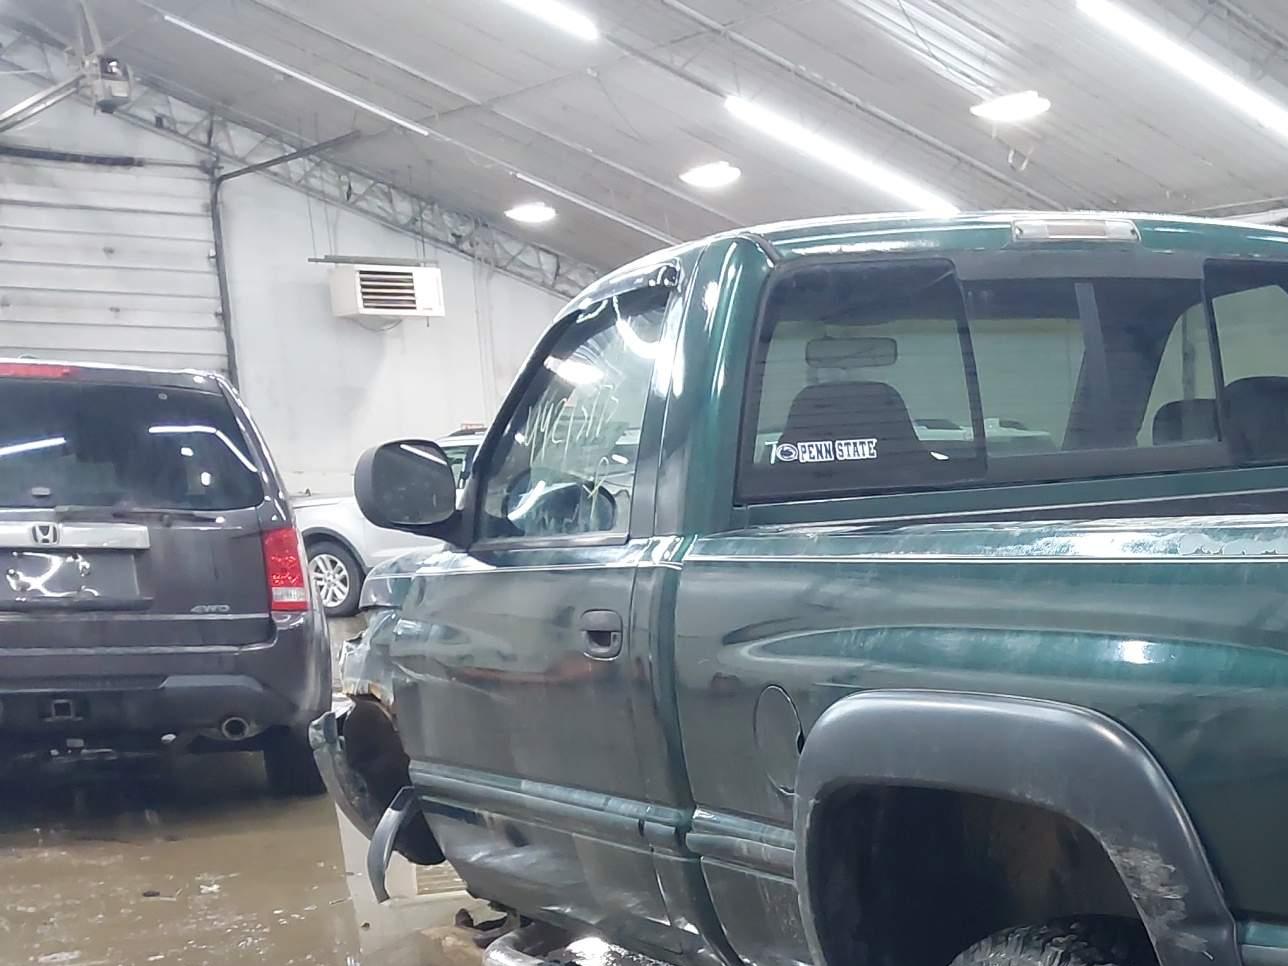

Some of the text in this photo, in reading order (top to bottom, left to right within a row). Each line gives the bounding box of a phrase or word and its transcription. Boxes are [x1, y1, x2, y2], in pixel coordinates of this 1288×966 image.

[799, 439, 876, 462] PENN STATE
[189, 604, 231, 613] 4WD
